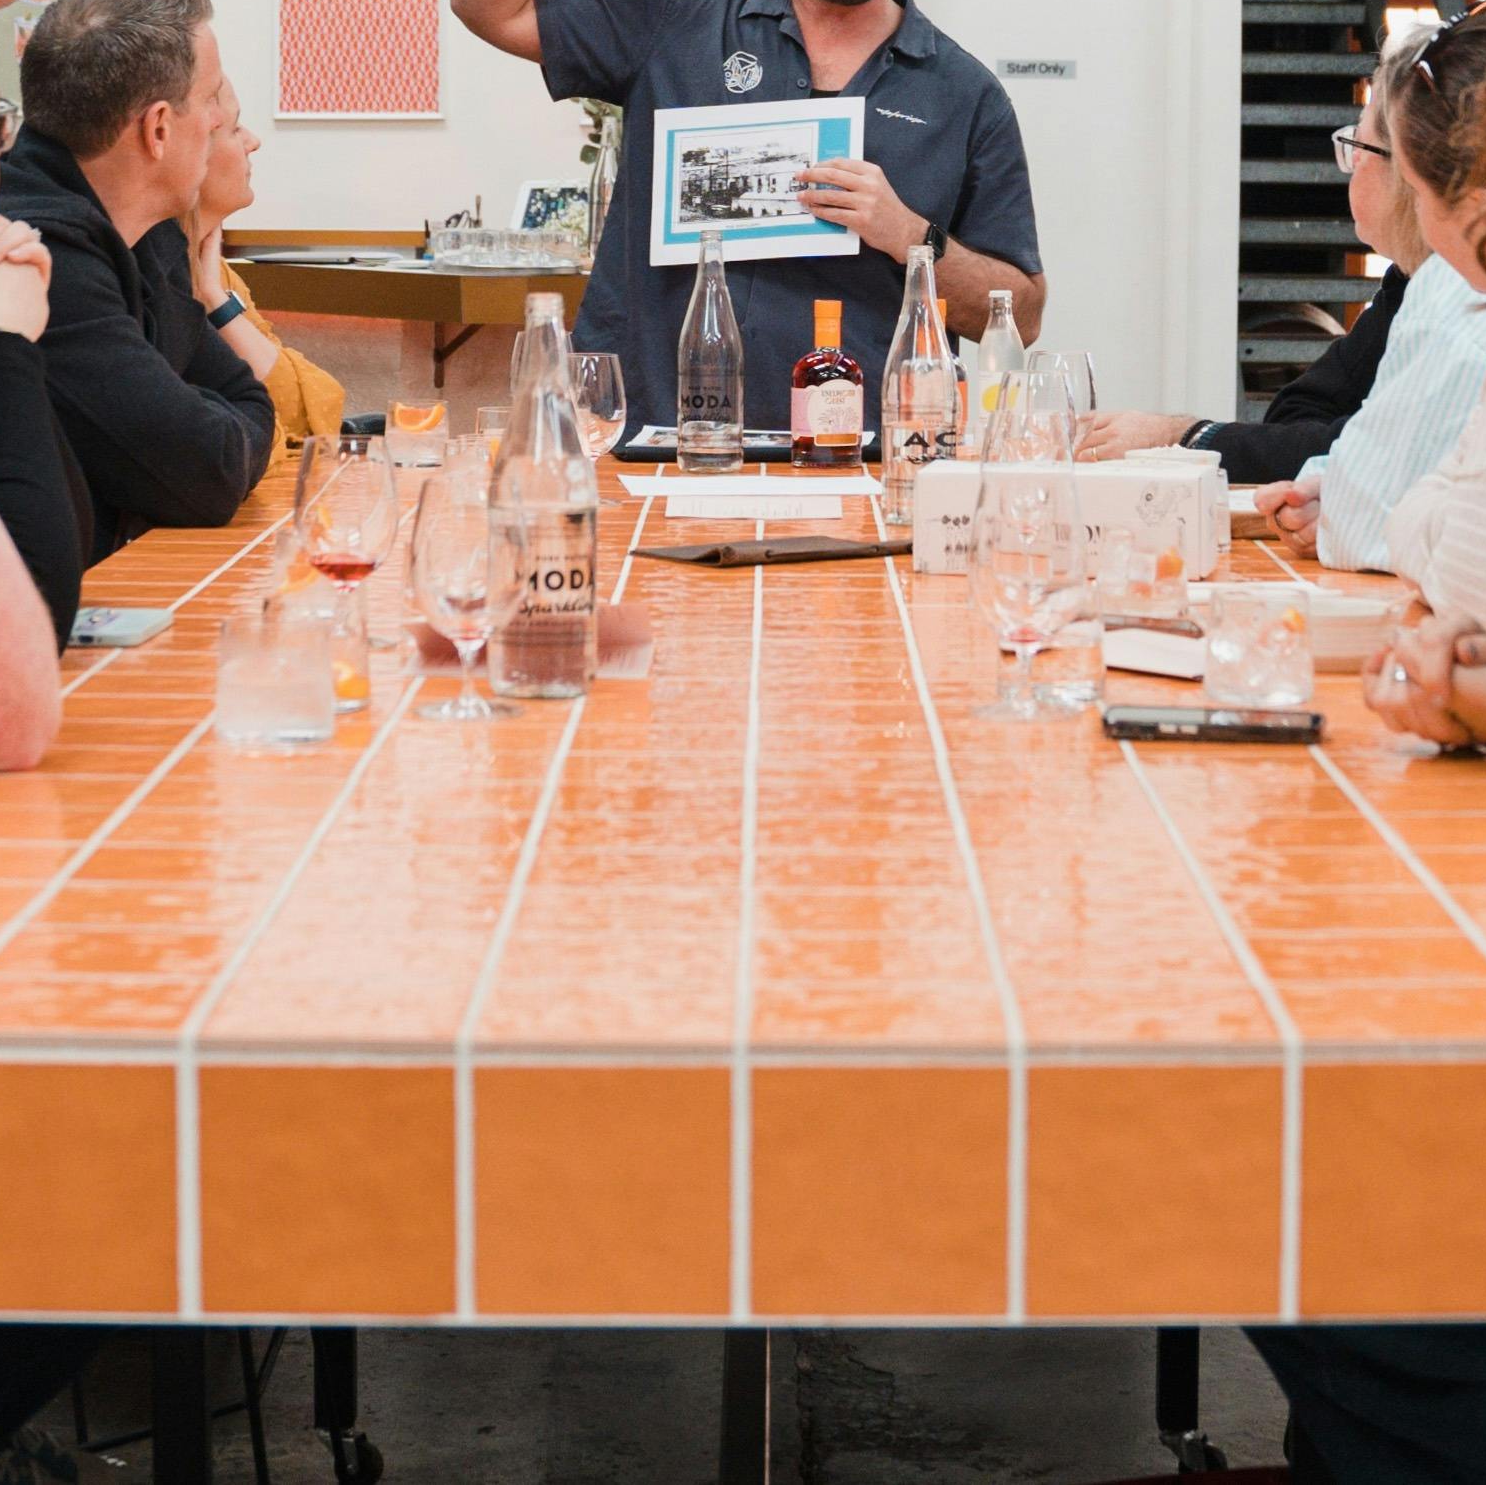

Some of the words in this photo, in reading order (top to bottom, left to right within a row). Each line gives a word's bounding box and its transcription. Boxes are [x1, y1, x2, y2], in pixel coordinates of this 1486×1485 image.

[1006, 62, 1036, 74] Staff
[1038, 62, 1065, 76] Only
[681, 395, 732, 409] MODA
